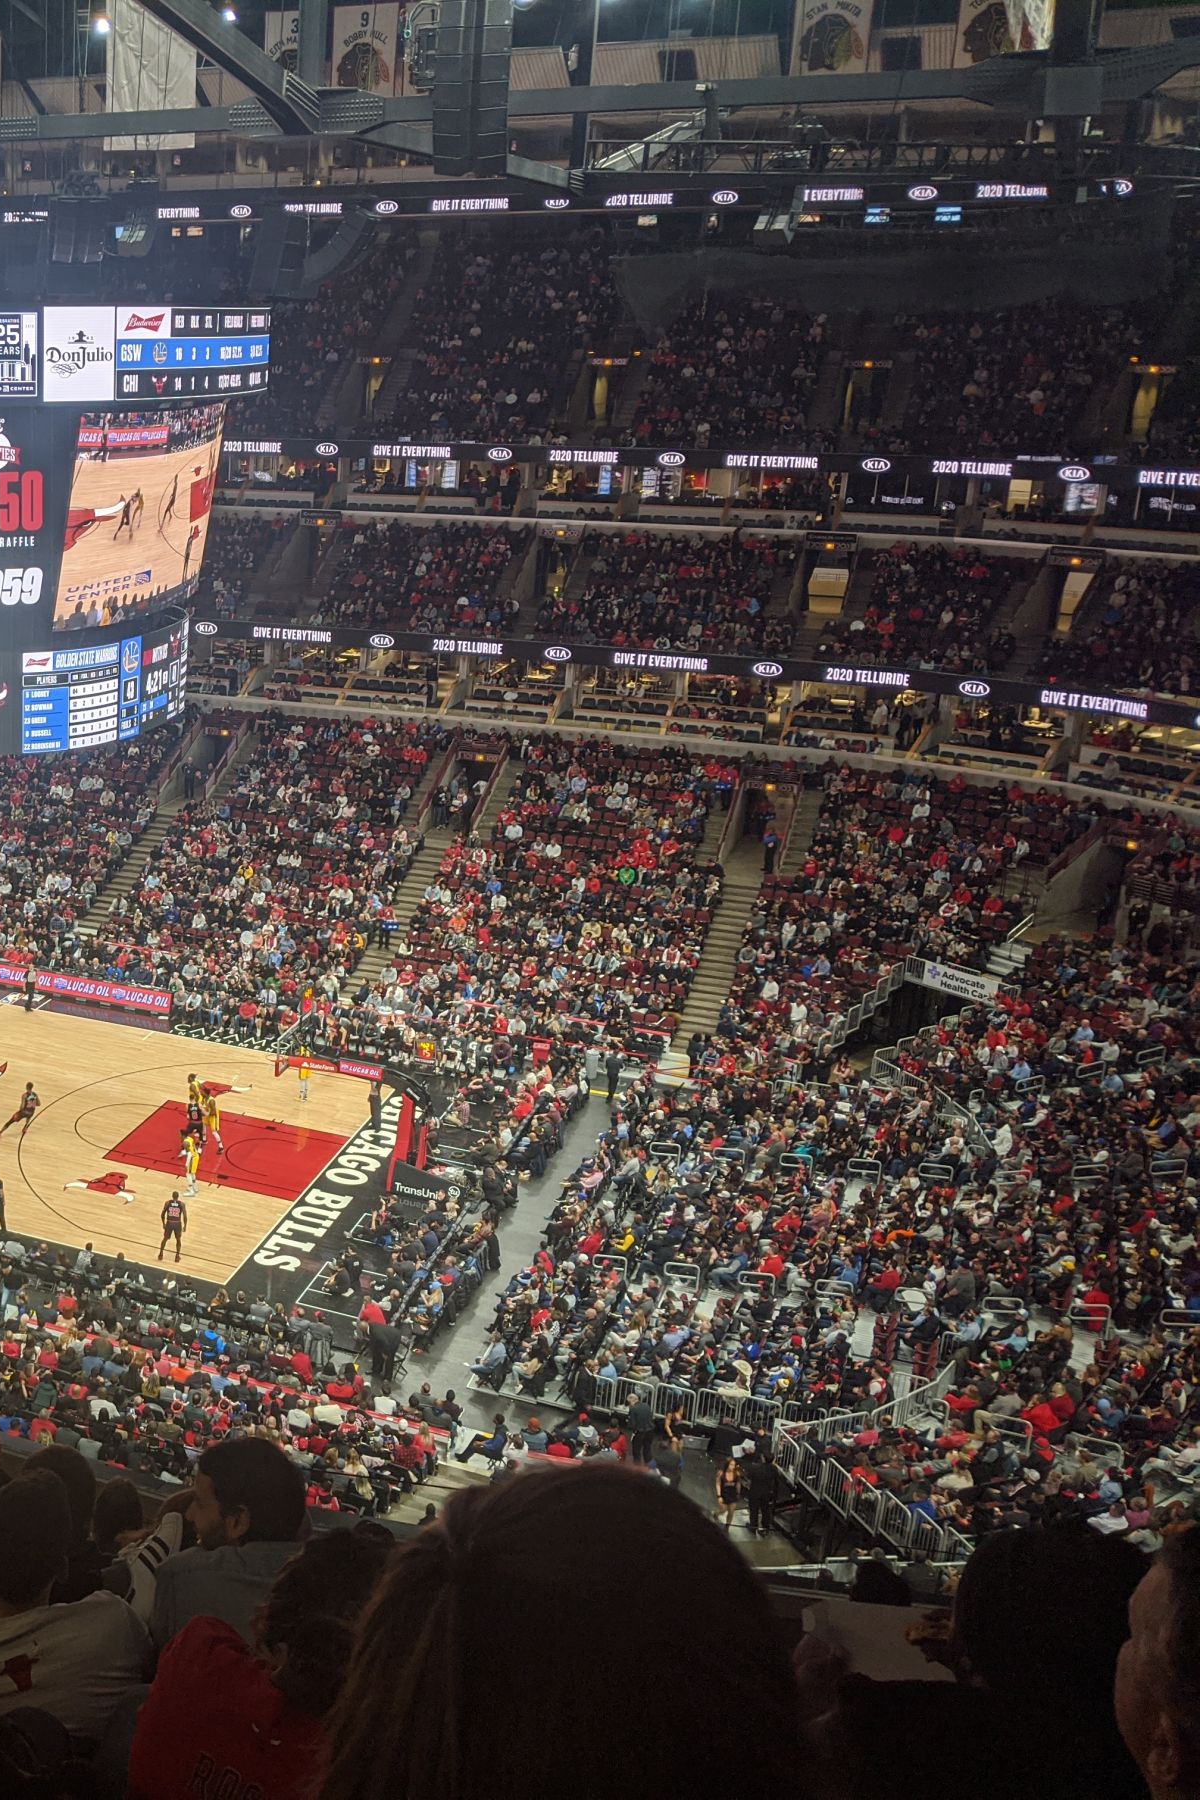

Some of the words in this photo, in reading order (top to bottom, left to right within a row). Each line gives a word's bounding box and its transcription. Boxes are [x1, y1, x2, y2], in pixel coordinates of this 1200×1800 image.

[361, 11, 369, 27] 9
[343, 29, 368, 47] BOBBY
[716, 193, 735, 202] KIA
[912, 188, 934, 198] KIA
[977, 185, 1002, 197] 2020
[159, 208, 199, 218] EVERYTHING
[129, 317, 163, 327] Budweiser
[121, 344, 142, 362] GSW
[123, 374, 139, 392] CHI
[550, 450, 571, 461] 2020
[574, 451, 618, 462] TELLURIDE
[662, 454, 682, 463] KIA
[727, 455, 748, 466] GIVE
[750, 456, 759, 466] IT
[761, 456, 817, 468] EVERYTHING
[865, 460, 887, 470] KIA
[933, 461, 958, 473] 2020
[961, 462, 1012, 475] TELLURIDE
[1062, 468, 1086, 479] KIA
[1139, 471, 1164, 484] GIVE
[1166, 472, 1177, 484] IT
[0, 536, 35, 548] RAFFLE
[67, 575, 131, 593] UNITED
[64, 583, 131, 602] CENTER
[55, 652, 79, 668] GOLDEN
[79, 650, 94, 665] STATE
[548, 649, 568, 658] KIA
[614, 653, 635, 664] GIVE
[637, 654, 647, 665] IT
[649, 655, 707, 670] EVERYTHING
[756, 664, 779, 674] KIA
[826, 668, 853, 681] 2020
[856, 670, 910, 686] TELLURIDE
[962, 683, 987, 694] KIA
[1041, 690, 1067, 705] GIVE
[1068, 694, 1080, 706] IT
[1081, 695, 1147, 717] EVERYTHING
[38, 974, 51, 986] OIL
[941, 970, 986, 990] Advocate
[67, 980, 95, 994] LUCAS
[96, 984, 110, 997] OIL
[940, 979, 970, 996] Health
[125, 989, 153, 1004] LUCAS
[155, 994, 169, 1007] OIL
[348, 1065, 369, 1075] LUCAS
[369, 1068, 380, 1076] OIL
[394, 1181, 438, 1200] TransUni
[169, 1207, 180, 1218] 32
[253, 1188, 354, 1272] BULLS
